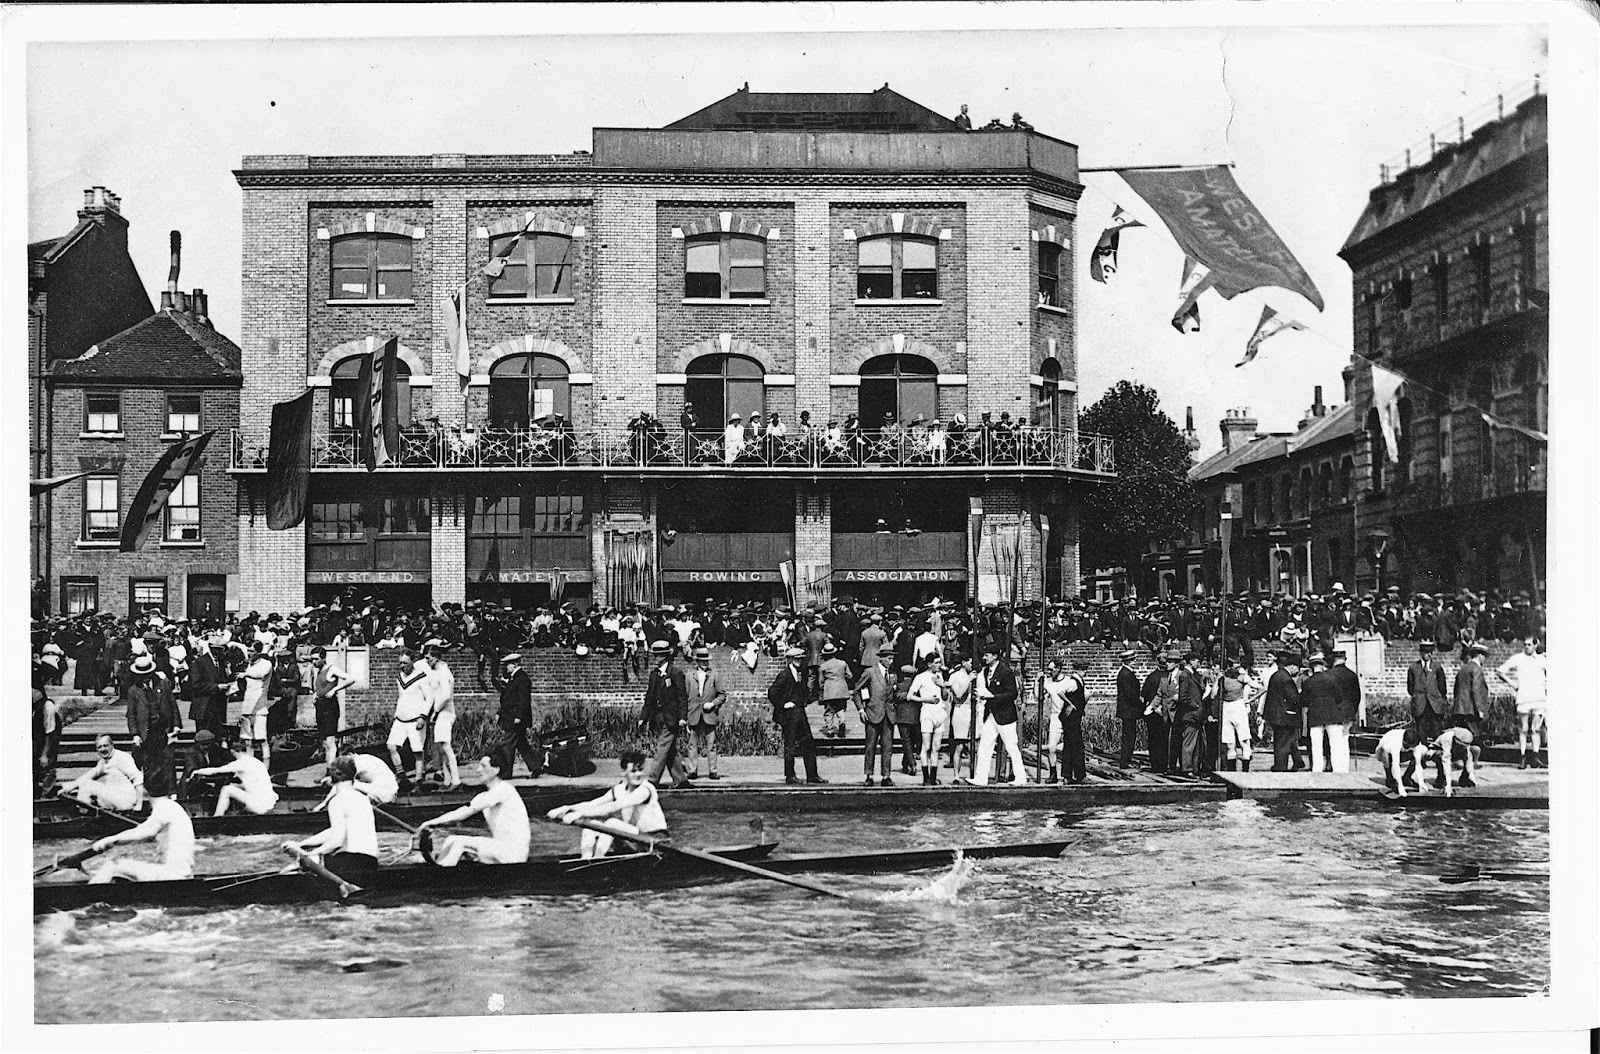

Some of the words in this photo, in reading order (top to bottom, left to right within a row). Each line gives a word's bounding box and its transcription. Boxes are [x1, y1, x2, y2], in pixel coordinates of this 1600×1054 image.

[321, 572, 369, 582] WEST
[378, 572, 414, 582] END
[690, 571, 760, 581] ROWING
[845, 571, 953, 581] ASSOCIATION.
